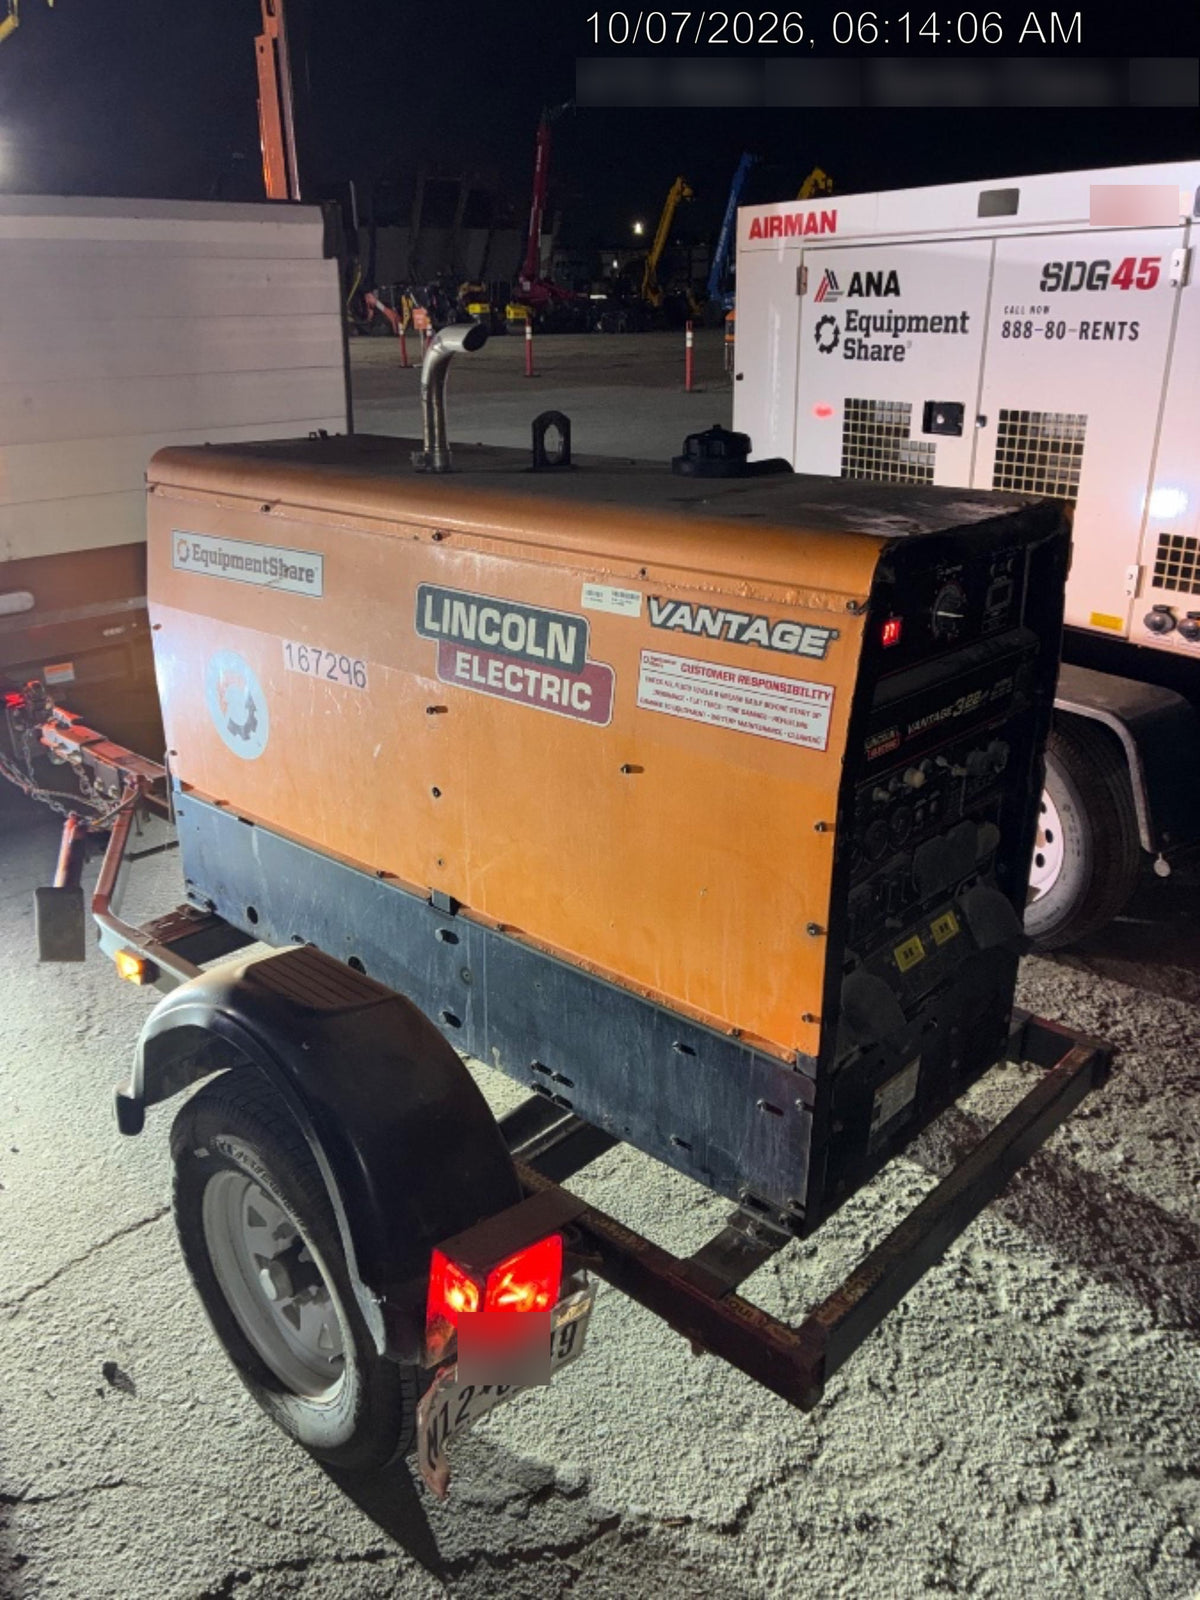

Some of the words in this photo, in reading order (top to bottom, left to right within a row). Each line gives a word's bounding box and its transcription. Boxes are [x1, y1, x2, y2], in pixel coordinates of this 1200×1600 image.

[749, 209, 838, 240] AIRMAN
[847, 269, 901, 298] ANA
[1040, 257, 1162, 293] SDG45
[844, 309, 970, 338] Equipment
[1001, 320, 1141, 342] 888-80-RENTS
[423, 593, 577, 664] LINCOLN
[284, 642, 367, 689] 167296
[454, 650, 592, 712] ELECTRIC
[680, 662, 736, 683] CUSTOMER
[737, 673, 830, 702] RESPONSIBILITY
